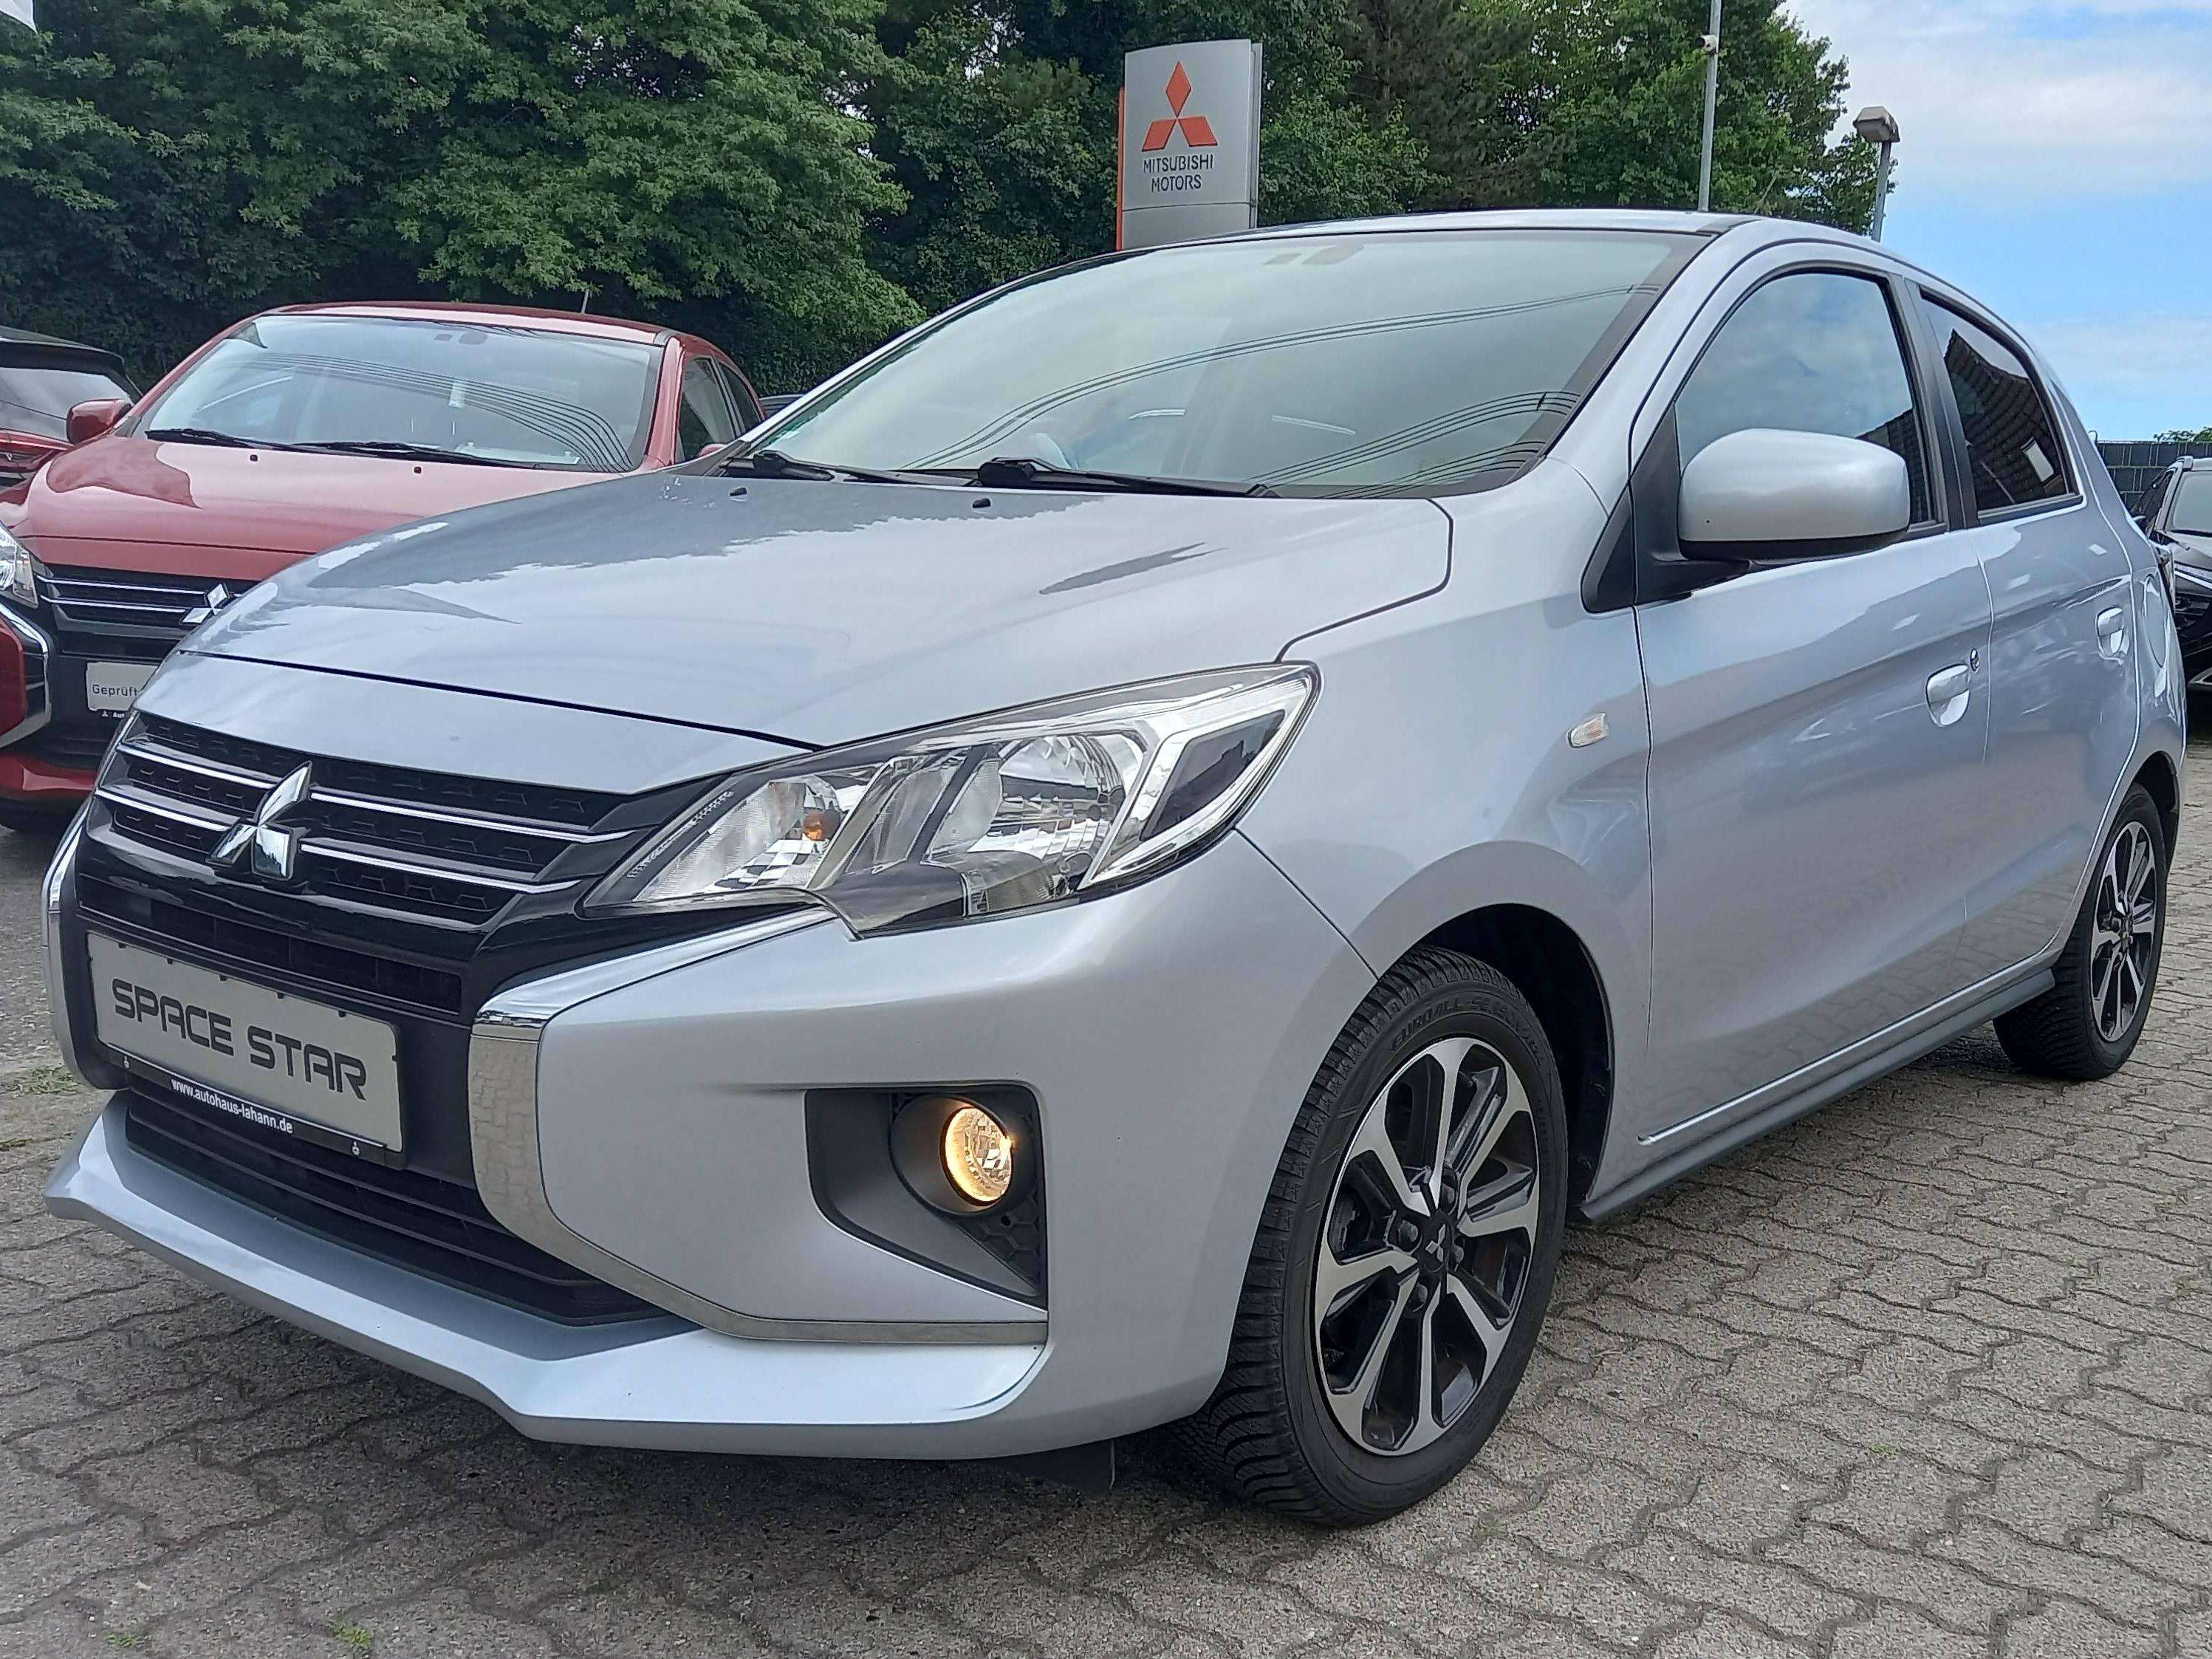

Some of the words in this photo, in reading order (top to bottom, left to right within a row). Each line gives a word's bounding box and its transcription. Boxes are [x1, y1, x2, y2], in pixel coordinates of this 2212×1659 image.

[1143, 154, 1213, 174] MITSUBISHI
[1151, 174, 1202, 193] MOTORS
[92, 684, 139, 697] Geprüft
[112, 978, 235, 1057] SPACE
[247, 1025, 367, 1101] STAR
[171, 1077, 294, 1135] www.autohaus-lahann.de
